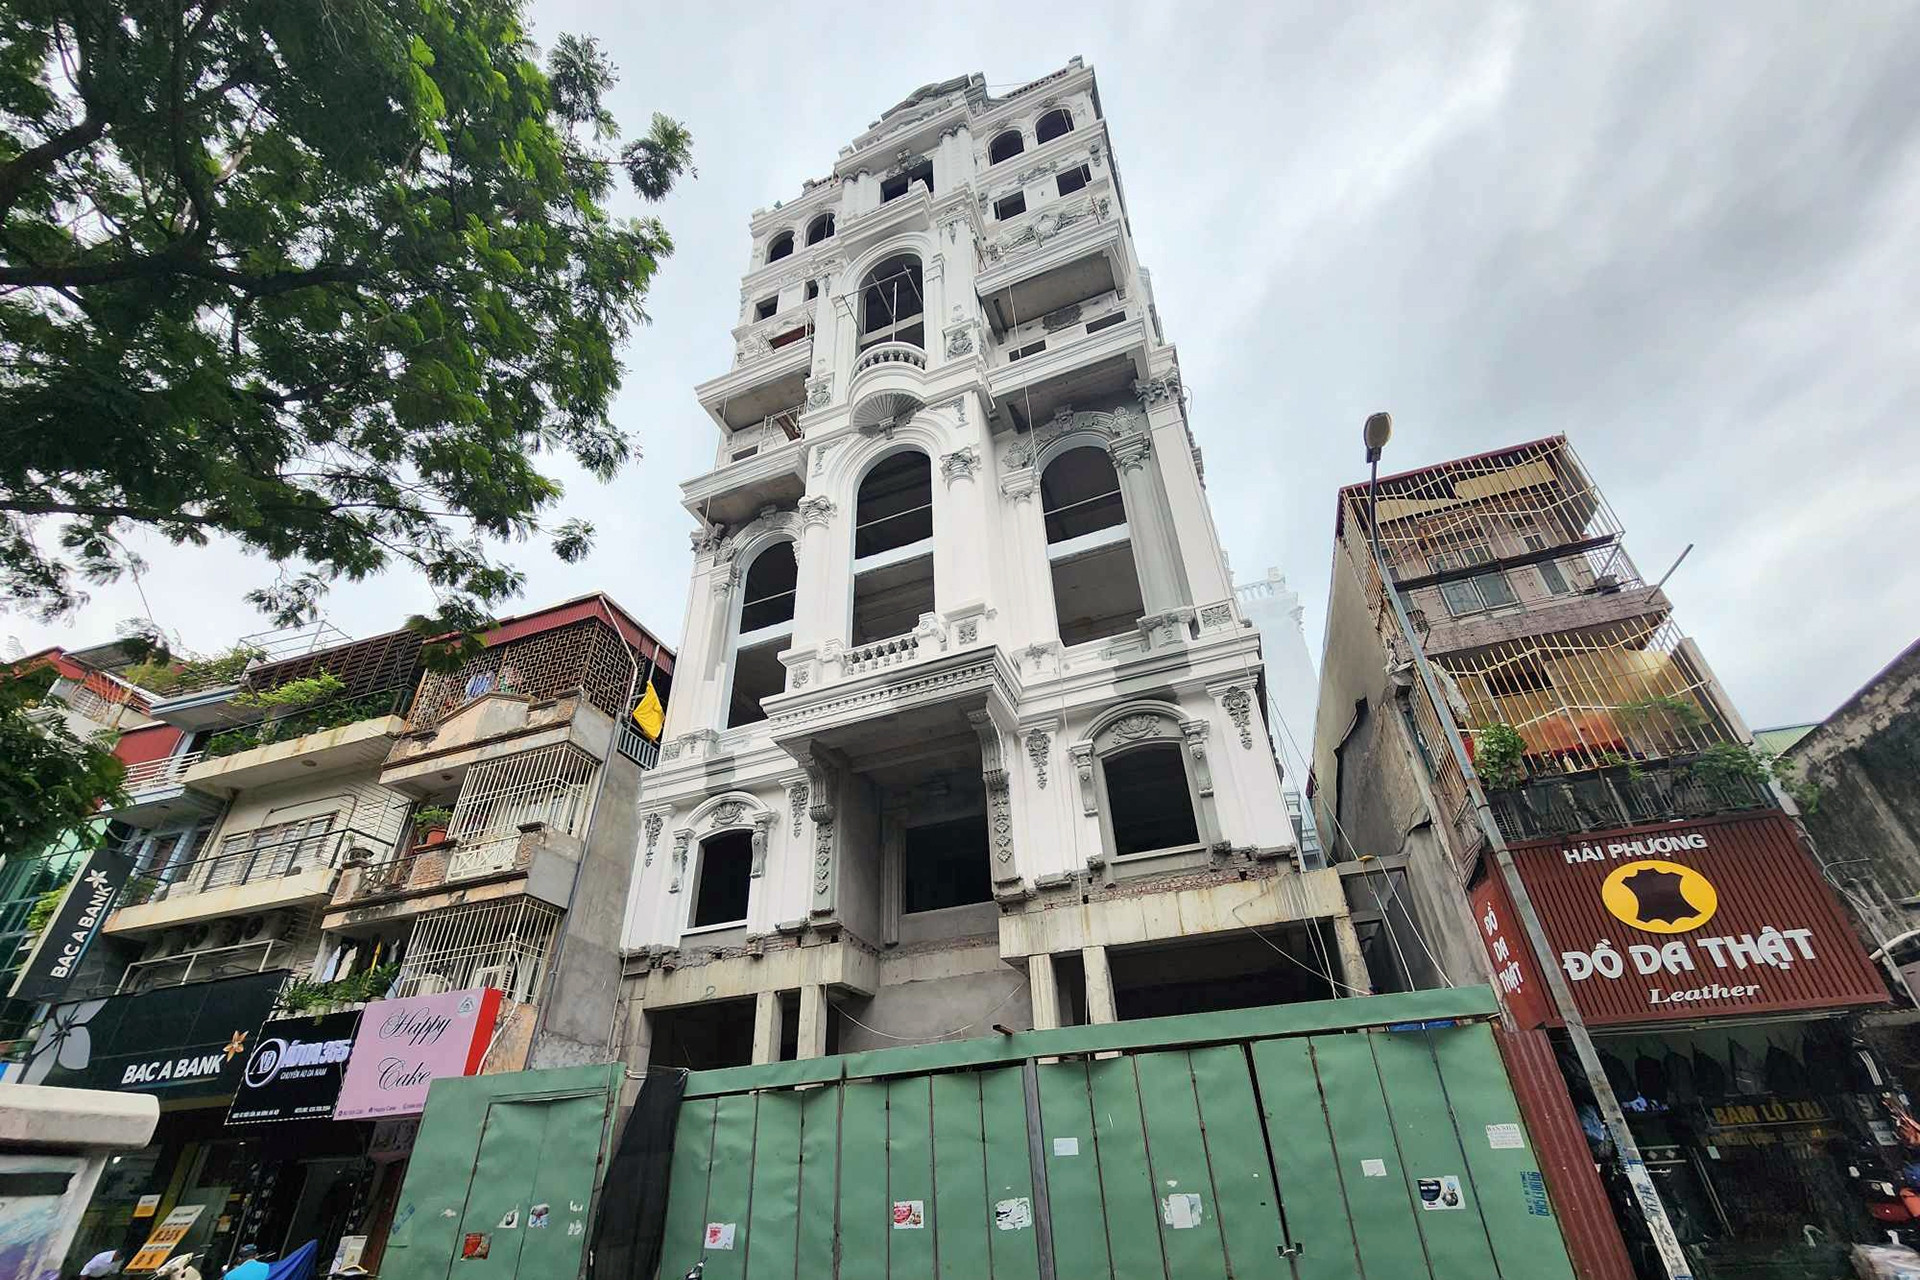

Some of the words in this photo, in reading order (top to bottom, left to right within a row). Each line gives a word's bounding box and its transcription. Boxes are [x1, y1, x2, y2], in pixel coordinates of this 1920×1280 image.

[1563, 842, 1605, 864] HẢI
[1607, 833, 1708, 858] PHƯỢNG
[77, 884, 114, 928] BANK
[71, 931, 90, 943] A
[1492, 936, 1510, 963] DA
[1561, 938, 1624, 981] ĐỒ
[1628, 941, 1695, 976] DA
[1697, 925, 1816, 970] THẬT
[50, 943, 80, 978] BAC
[1649, 983, 1761, 1004] Leather
[379, 1006, 452, 1047] Happy
[121, 1061, 160, 1084] BAC
[157, 1060, 173, 1080] A
[172, 1053, 226, 1078] BANK
[377, 1057, 431, 1091] Cake
